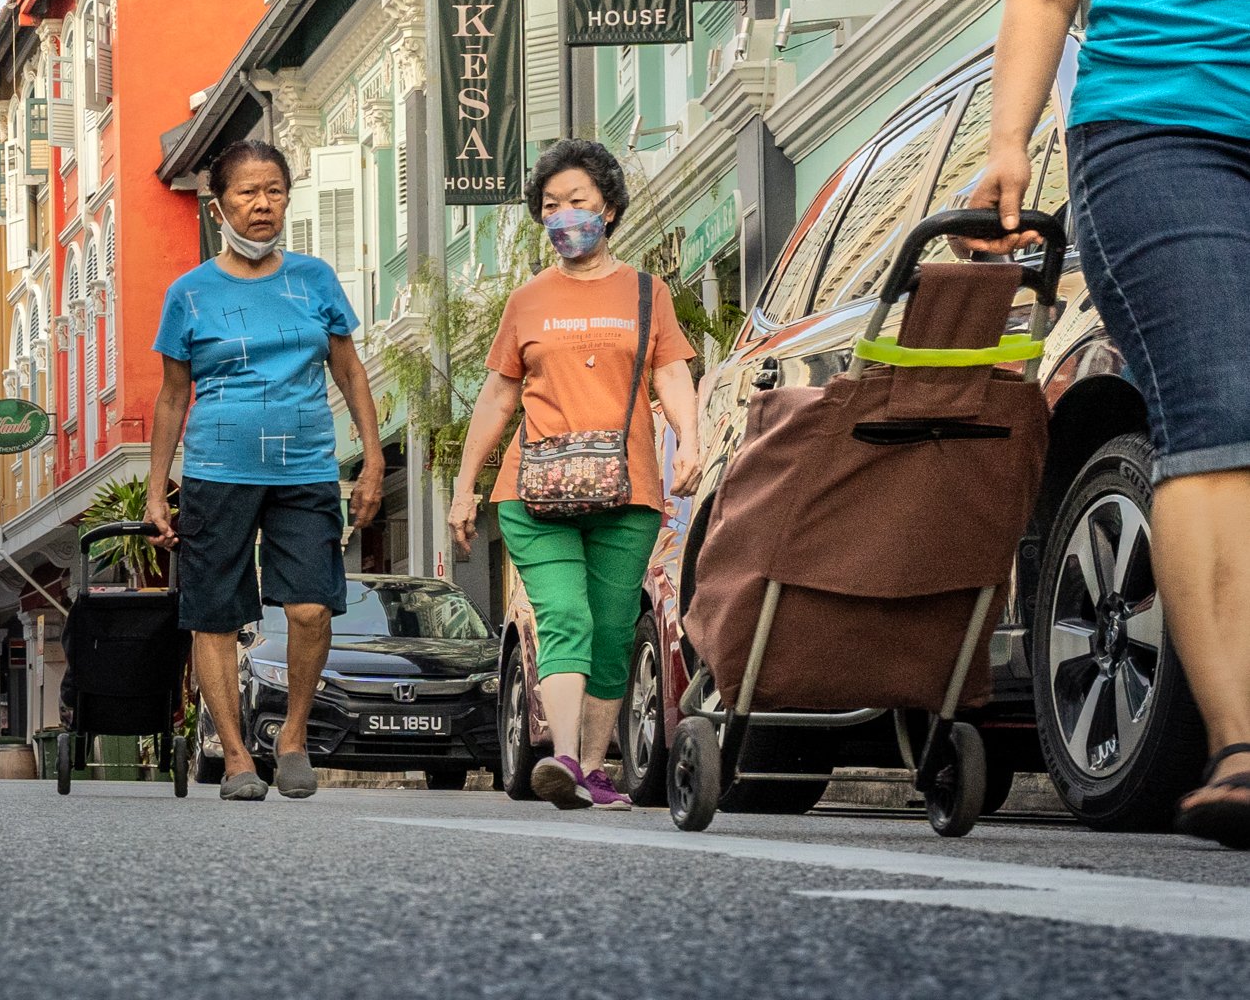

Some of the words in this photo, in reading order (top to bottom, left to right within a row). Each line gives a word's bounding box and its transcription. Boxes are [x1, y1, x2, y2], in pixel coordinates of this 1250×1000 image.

[588, 8, 667, 27] HOUSE
[443, 176, 506, 191] HOUSE
[543, 318, 551, 331] A
[553, 317, 587, 332] happy
[589, 317, 636, 332] moment
[22, 438, 34, 450] NASI
[34, 420, 47, 443] PADANG
